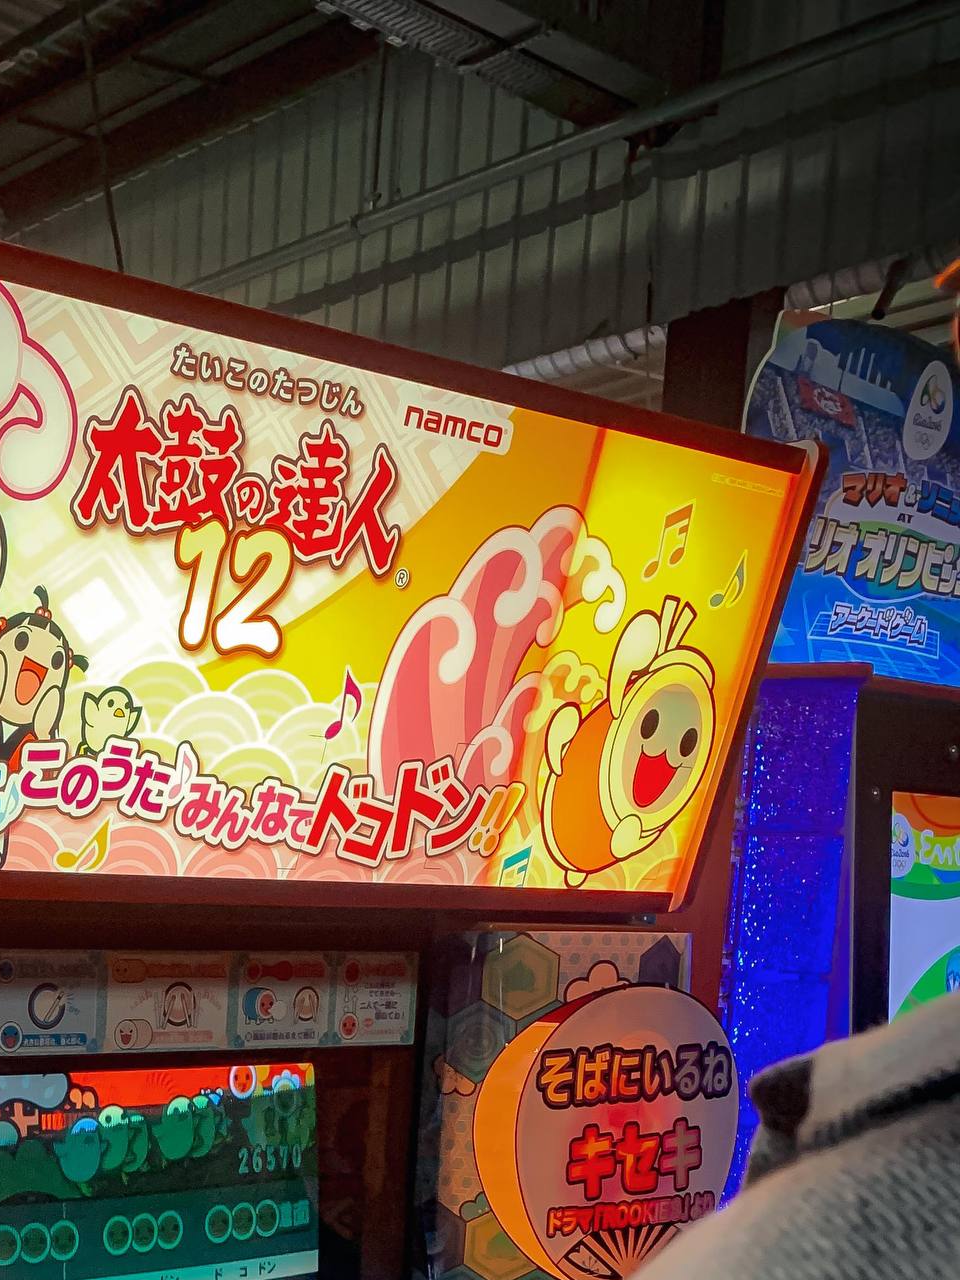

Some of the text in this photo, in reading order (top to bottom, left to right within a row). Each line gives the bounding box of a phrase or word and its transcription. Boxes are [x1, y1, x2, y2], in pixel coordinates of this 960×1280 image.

[169, 342, 365, 418] たいこのたつじん
[403, 404, 504, 448] namco
[71, 384, 401, 577] 太鼓の達人
[804, 516, 861, 575] リオ
[897, 513, 915, 524] AT
[174, 516, 294, 659] 12
[828, 601, 929, 648] アーケードゲーム
[19, 738, 170, 822] このうた
[535, 1040, 733, 1110] そばにいるね
[238, 1143, 303, 1175] 26570
[566, 1117, 702, 1201] キセキ
